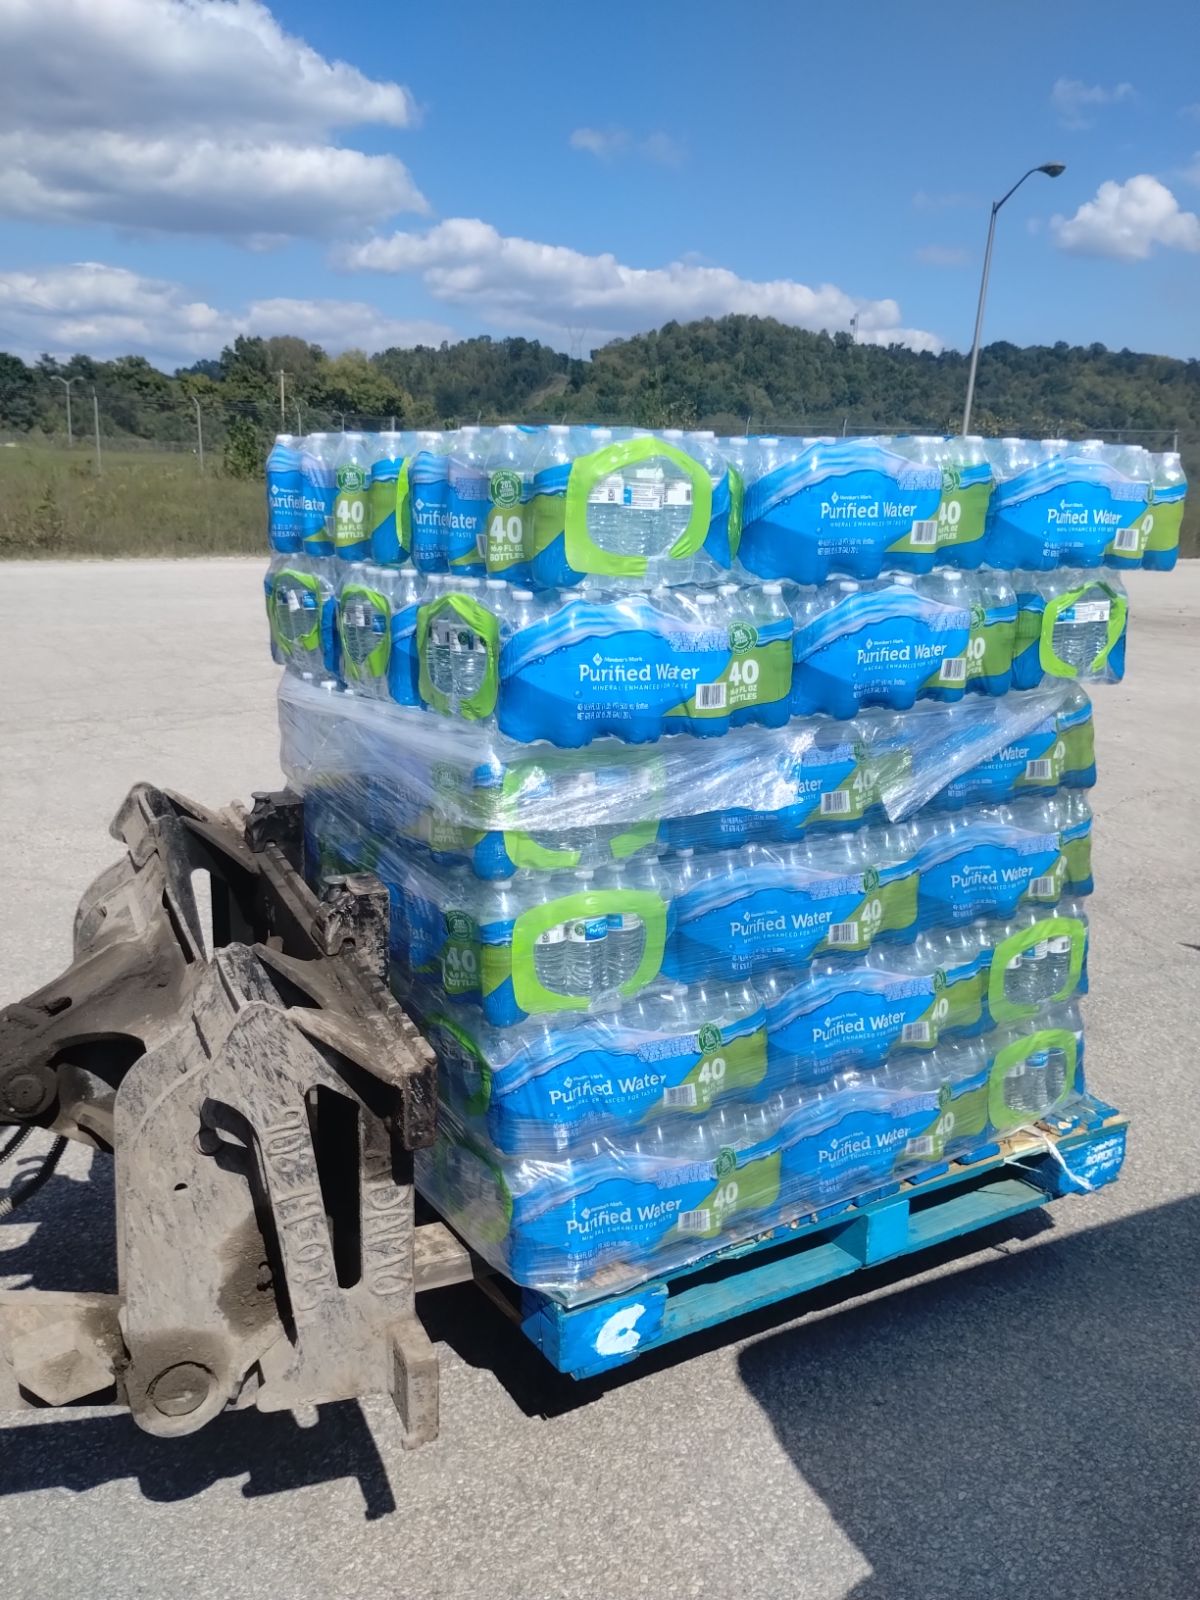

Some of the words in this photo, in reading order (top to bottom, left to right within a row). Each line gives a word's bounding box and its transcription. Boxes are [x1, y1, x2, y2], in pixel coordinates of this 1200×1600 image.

[336, 499, 364, 524] 40
[820, 502, 879, 519] Purified
[882, 502, 918, 518] Water
[1047, 509, 1089, 525] Purified
[1093, 509, 1123, 525] Water
[489, 515, 523, 544] 40
[857, 645, 911, 665] Purified
[914, 644, 948, 660] Water
[579, 663, 652, 682] Purified
[656, 663, 700, 680] Water
[729, 659, 760, 686] 40
[999, 747, 1030, 764] Water
[951, 870, 998, 889] Purified
[1001, 866, 1034, 882] Water
[730, 915, 787, 937] Purified
[791, 911, 833, 930] Water
[861, 899, 882, 925] 40
[447, 947, 477, 973] 40
[931, 998, 949, 1021] 40
[812, 1017, 865, 1043] Purified
[869, 1012, 906, 1031] Water
[698, 1057, 726, 1086] 40
[549, 1079, 614, 1105] Purified
[618, 1073, 667, 1095] Water
[641, 1087, 658, 1098] TASTE
[935, 1111, 955, 1136] 40
[819, 1136, 872, 1164] Purified
[876, 1128, 912, 1148] Water
[713, 1181, 739, 1213] 40
[566, 1208, 633, 1236] Purified
[637, 1199, 682, 1222] Water
